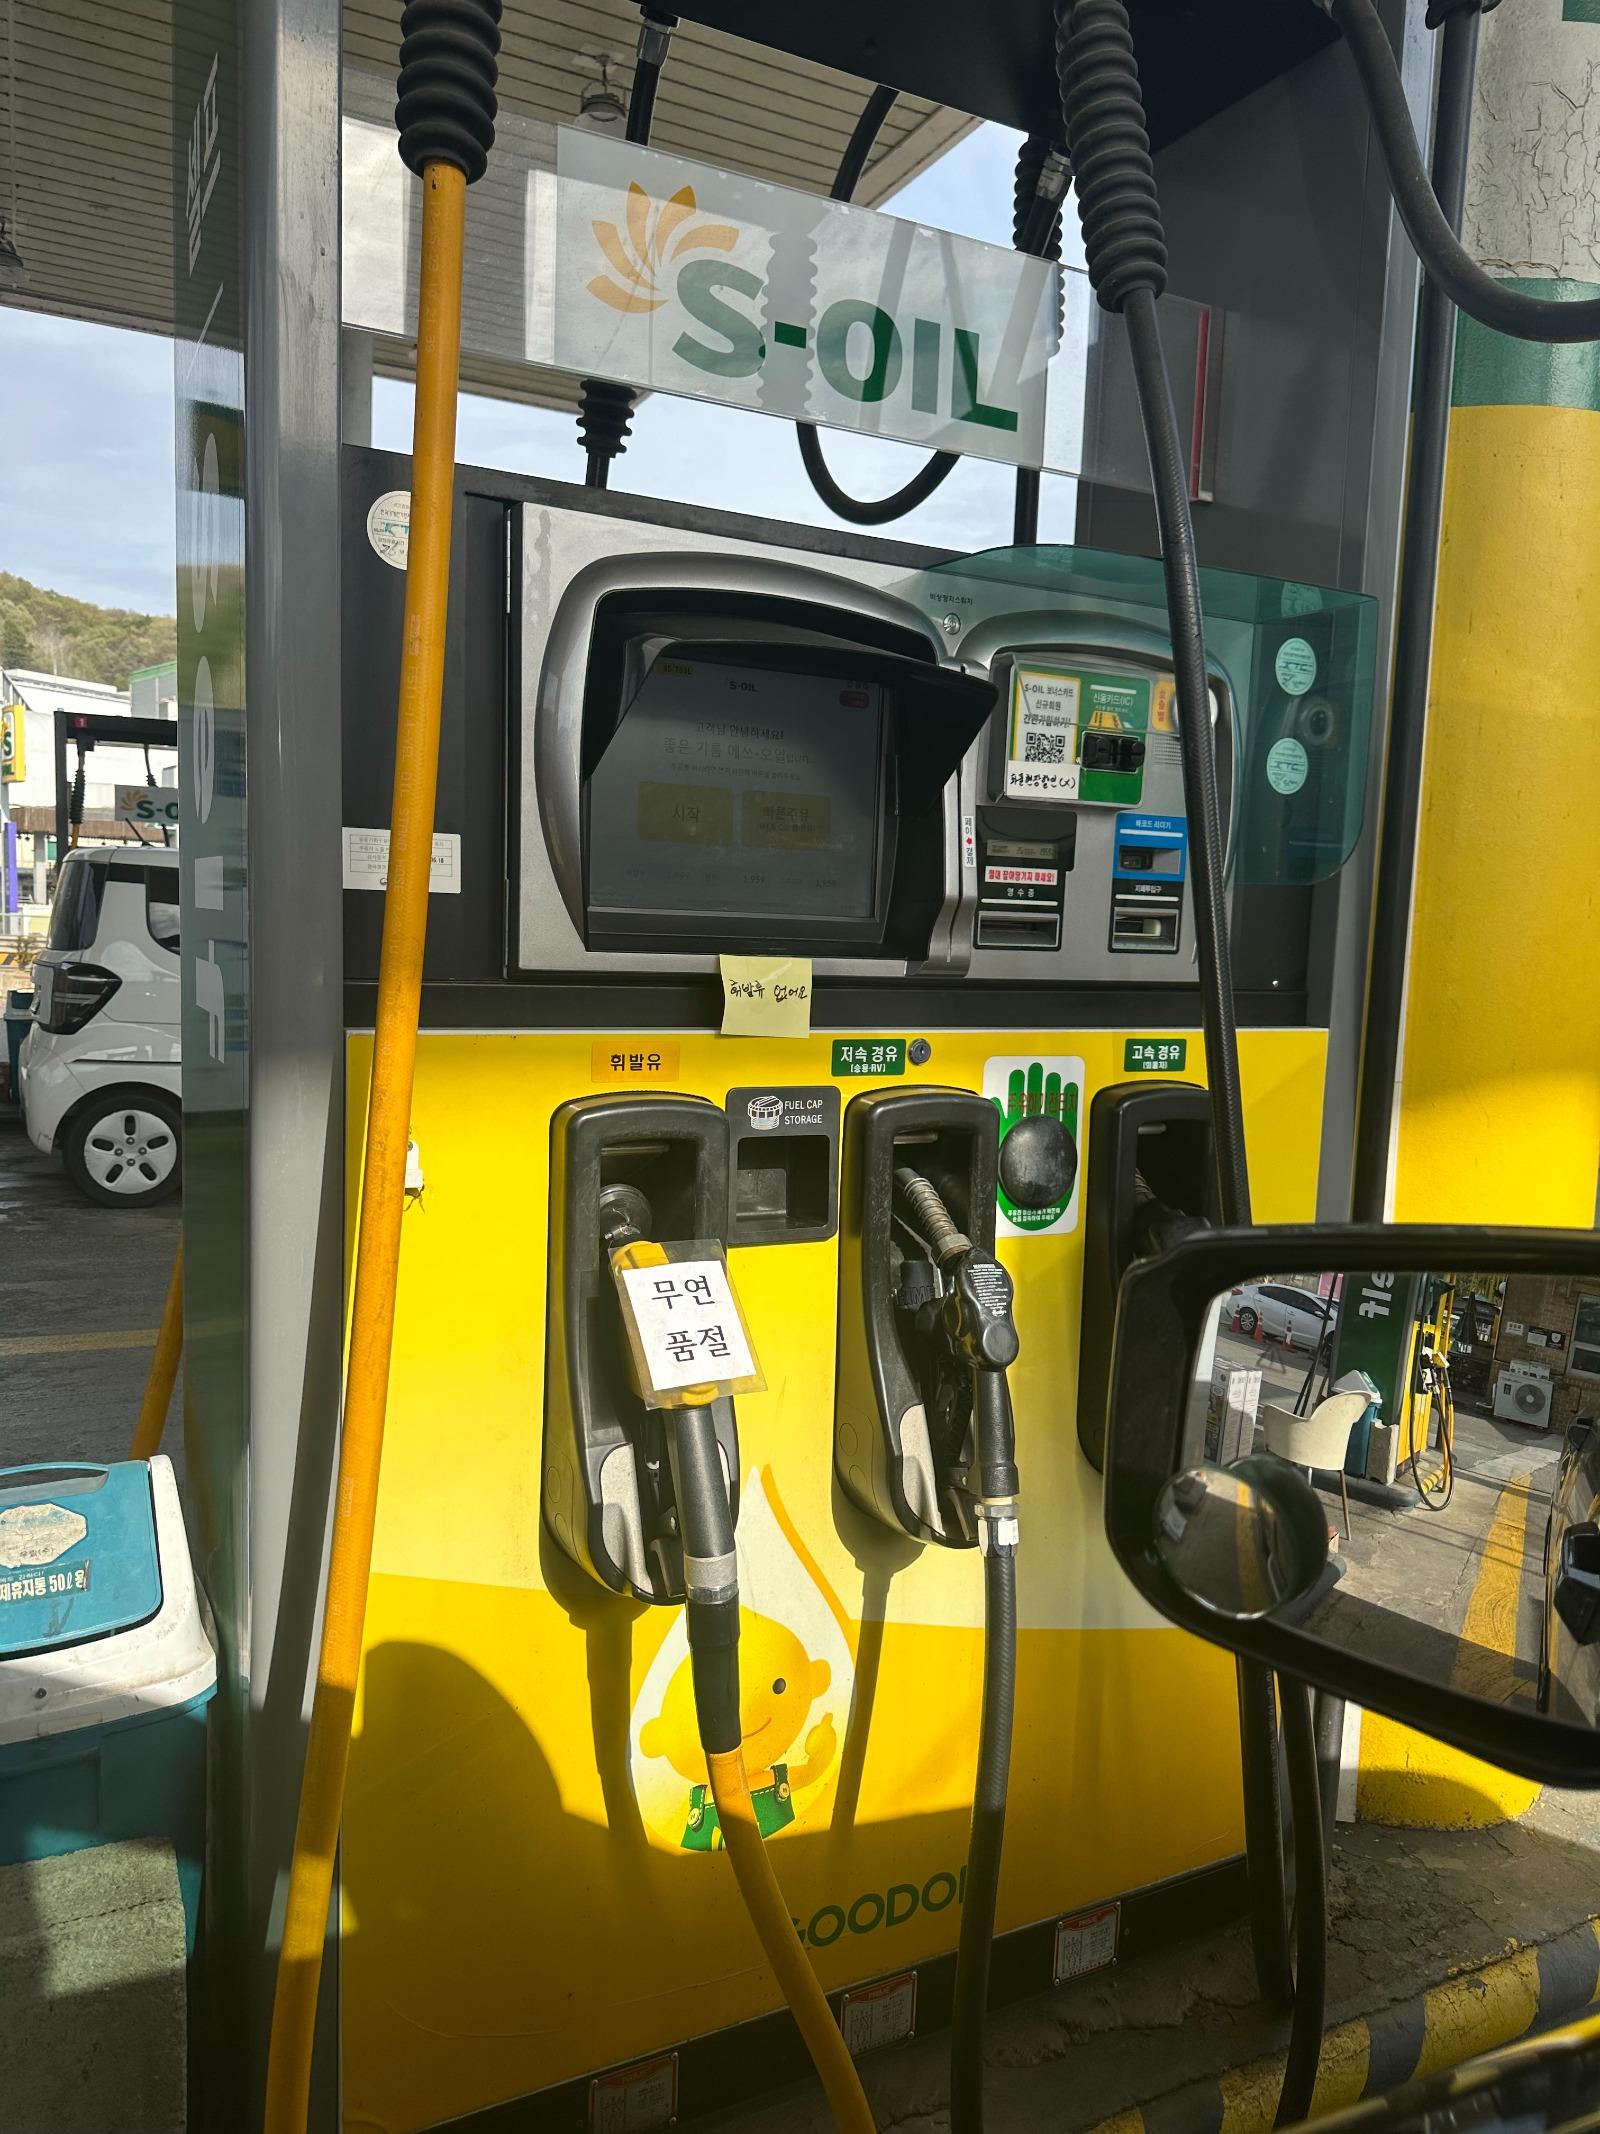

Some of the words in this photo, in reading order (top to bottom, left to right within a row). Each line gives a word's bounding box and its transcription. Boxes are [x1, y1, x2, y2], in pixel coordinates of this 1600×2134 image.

[672, 258, 1019, 433] S-OIL
[1023, 683, 1045, 694] S-OIL
[1046, 686, 1074, 698] 보너스카드
[192, 432, 225, 1065] Self
[136, 800, 179, 819] S-O
[672, 804, 702, 823] 시작
[773, 984, 808, 1003] 없어요
[840, 1045, 869, 1064] 저속
[871, 1045, 899, 1063] 경유
[1131, 1044, 1155, 1060] 고속
[1157, 1044, 1181, 1061] 경유
[610, 1053, 662, 1072] 휘발유
[784, 1100, 805, 1111] FUEL
[806, 1099, 823, 1110] CAP
[784, 1114, 823, 1126] STORAGE
[651, 1275, 716, 1310] 무연
[665, 1325, 732, 1363] 품절
